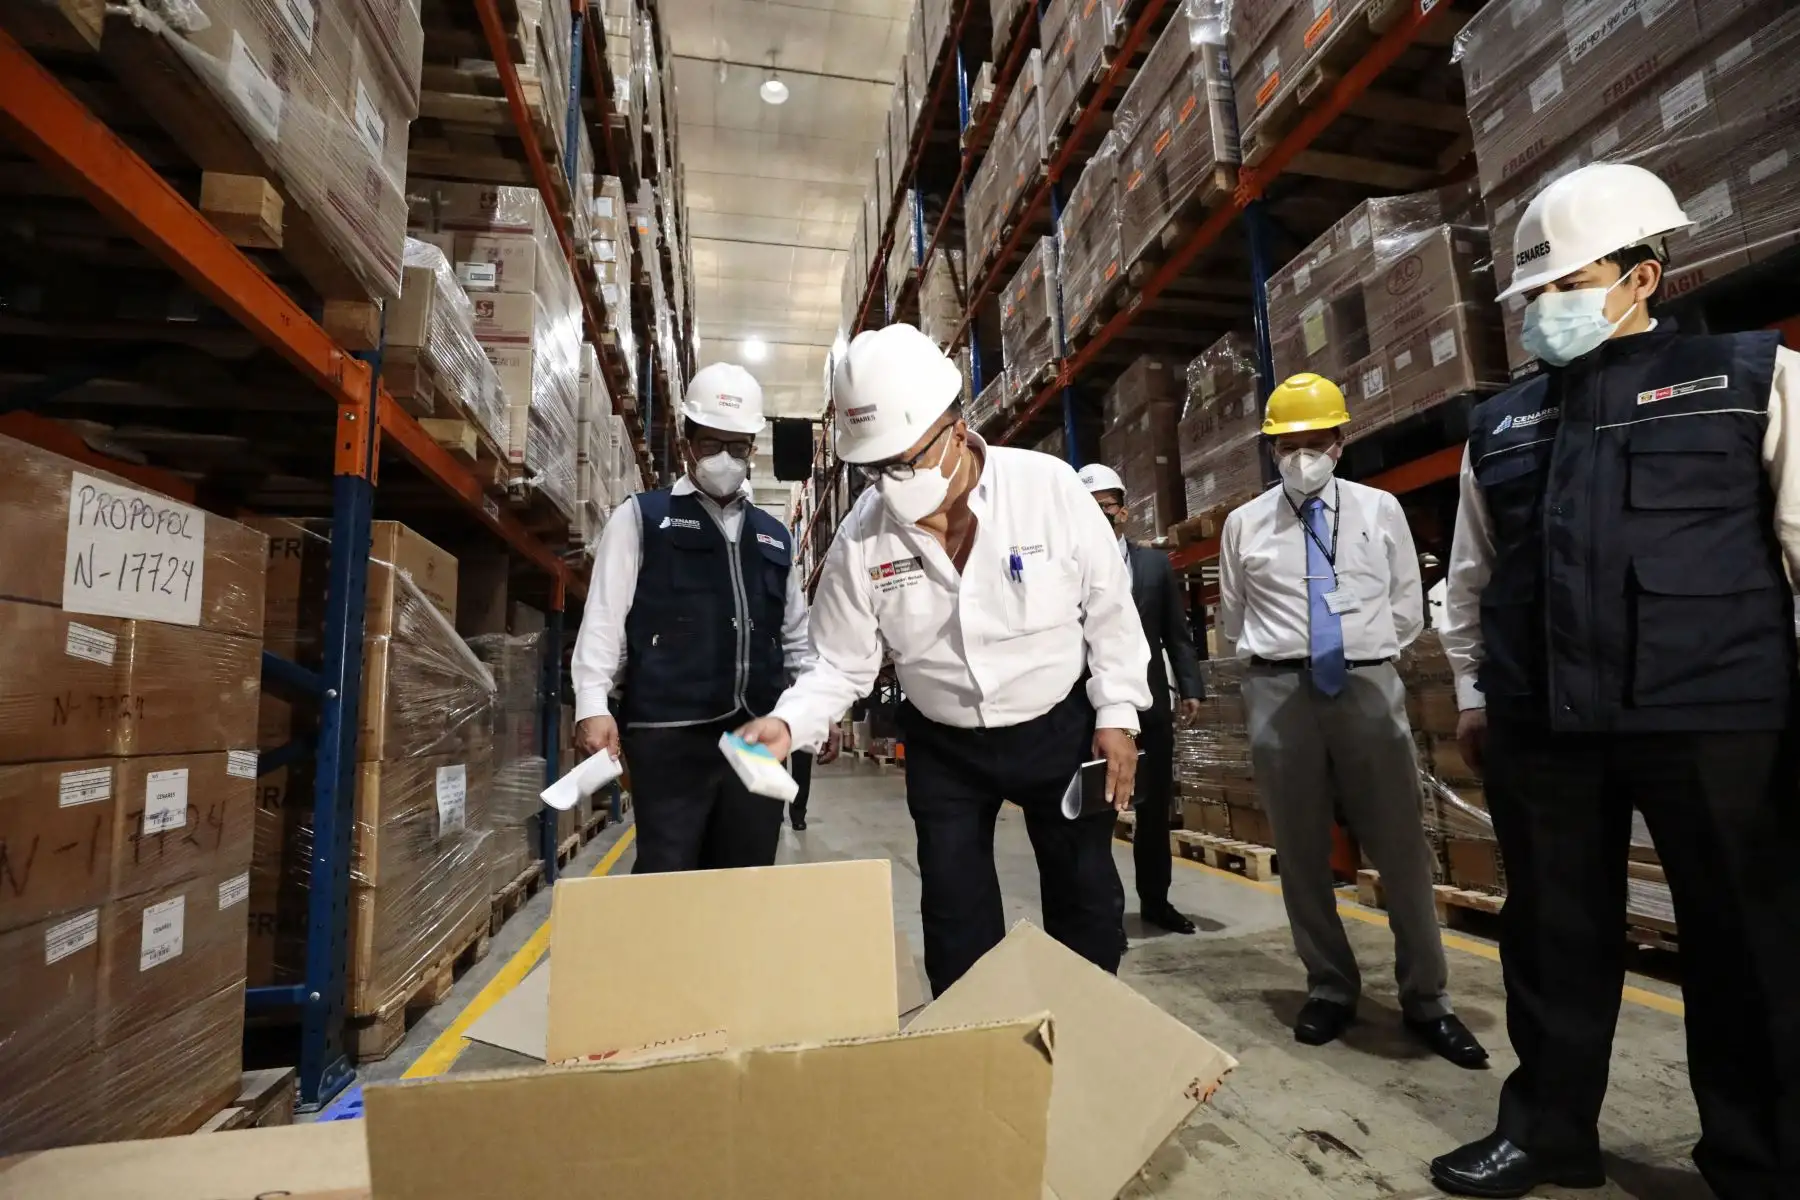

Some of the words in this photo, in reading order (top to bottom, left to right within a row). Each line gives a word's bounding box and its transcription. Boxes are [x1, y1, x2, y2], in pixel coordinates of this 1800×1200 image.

[1516, 241, 1551, 267] CENARES
[850, 414, 876, 425] CENARES
[1513, 407, 1560, 423] CENARES
[79, 485, 192, 539] PROPOFOL
[73, 543, 194, 601] N-17724
